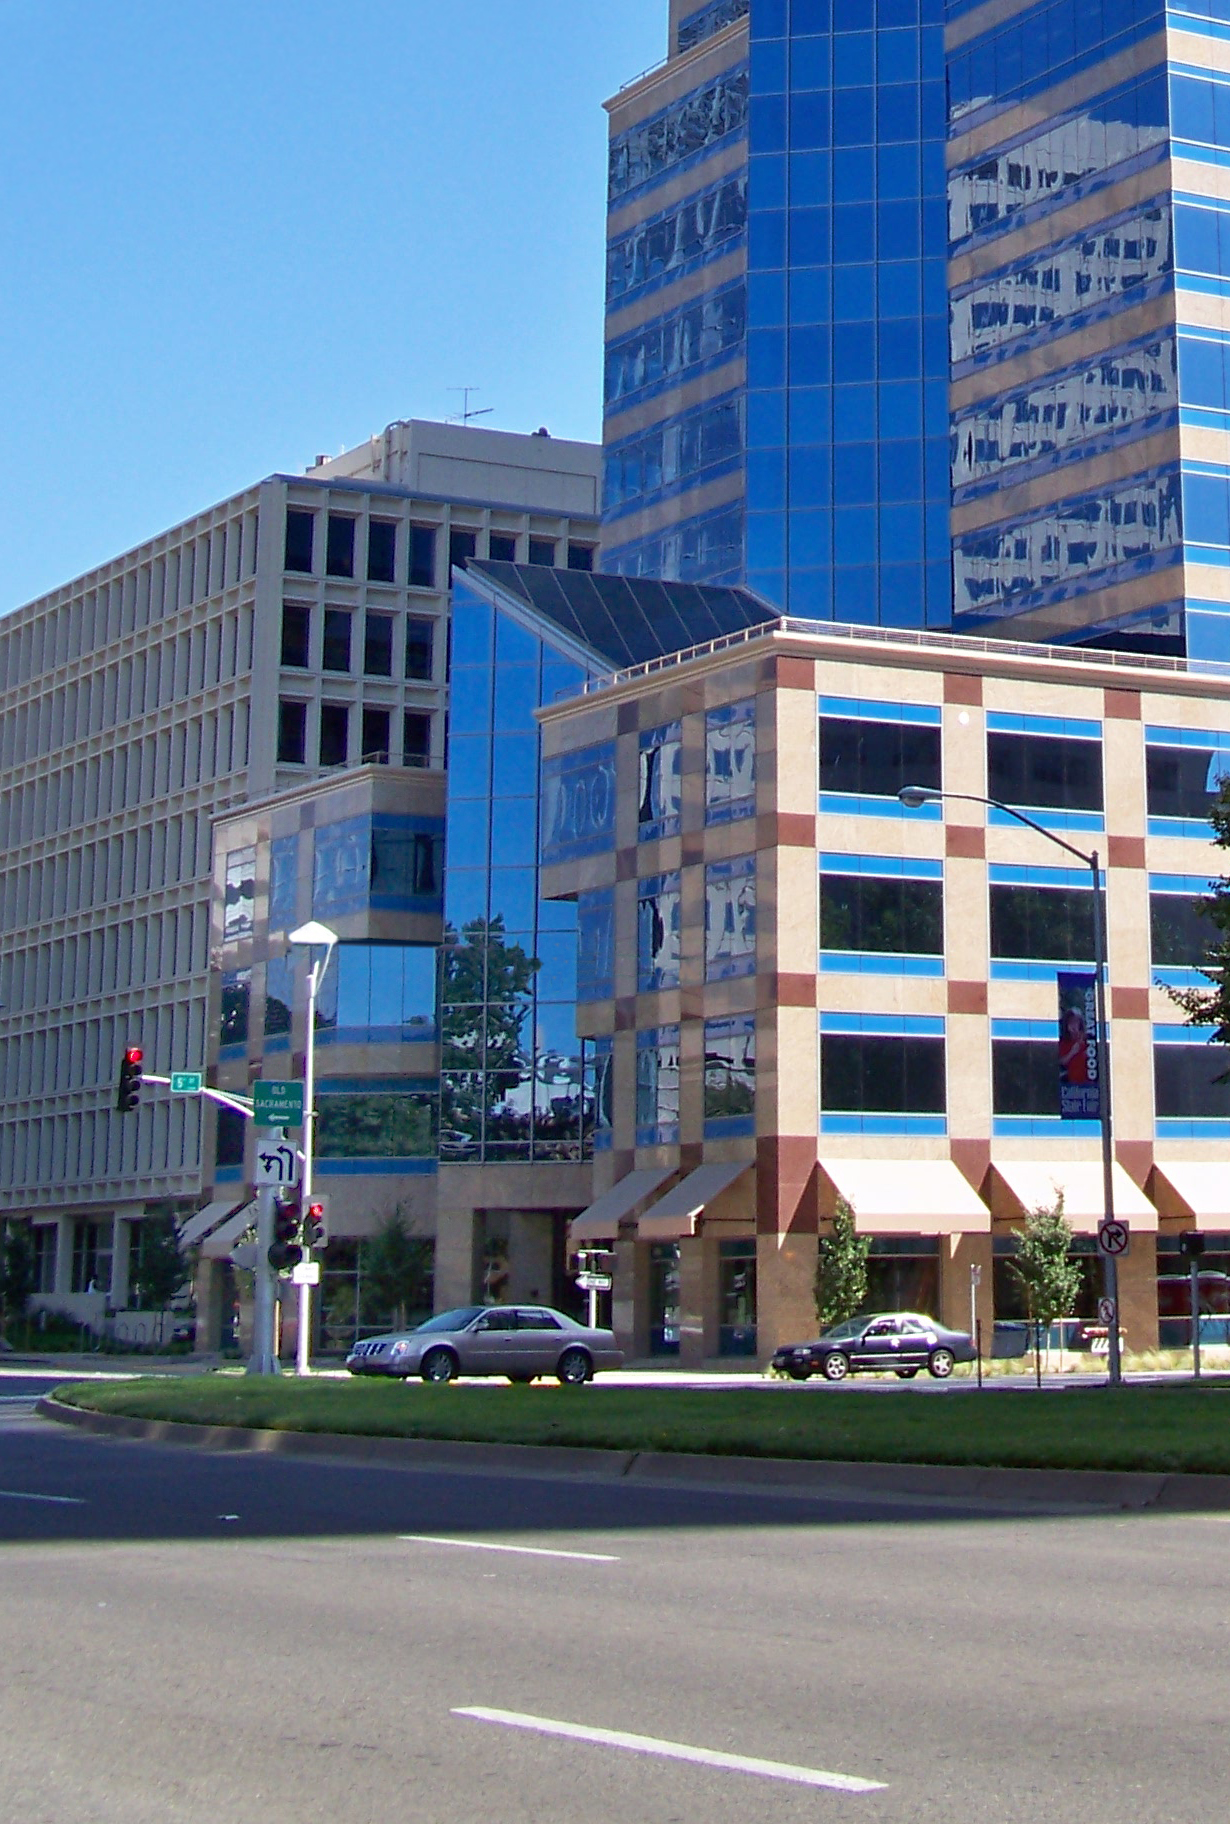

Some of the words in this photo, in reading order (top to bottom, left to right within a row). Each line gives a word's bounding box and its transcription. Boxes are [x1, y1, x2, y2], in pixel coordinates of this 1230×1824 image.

[1085, 987, 1095, 1037] GREAT
[1087, 1040, 1097, 1081] FOOD
[271, 1085, 286, 1095] OLD
[255, 1098, 302, 1109] SACRAMENTO
